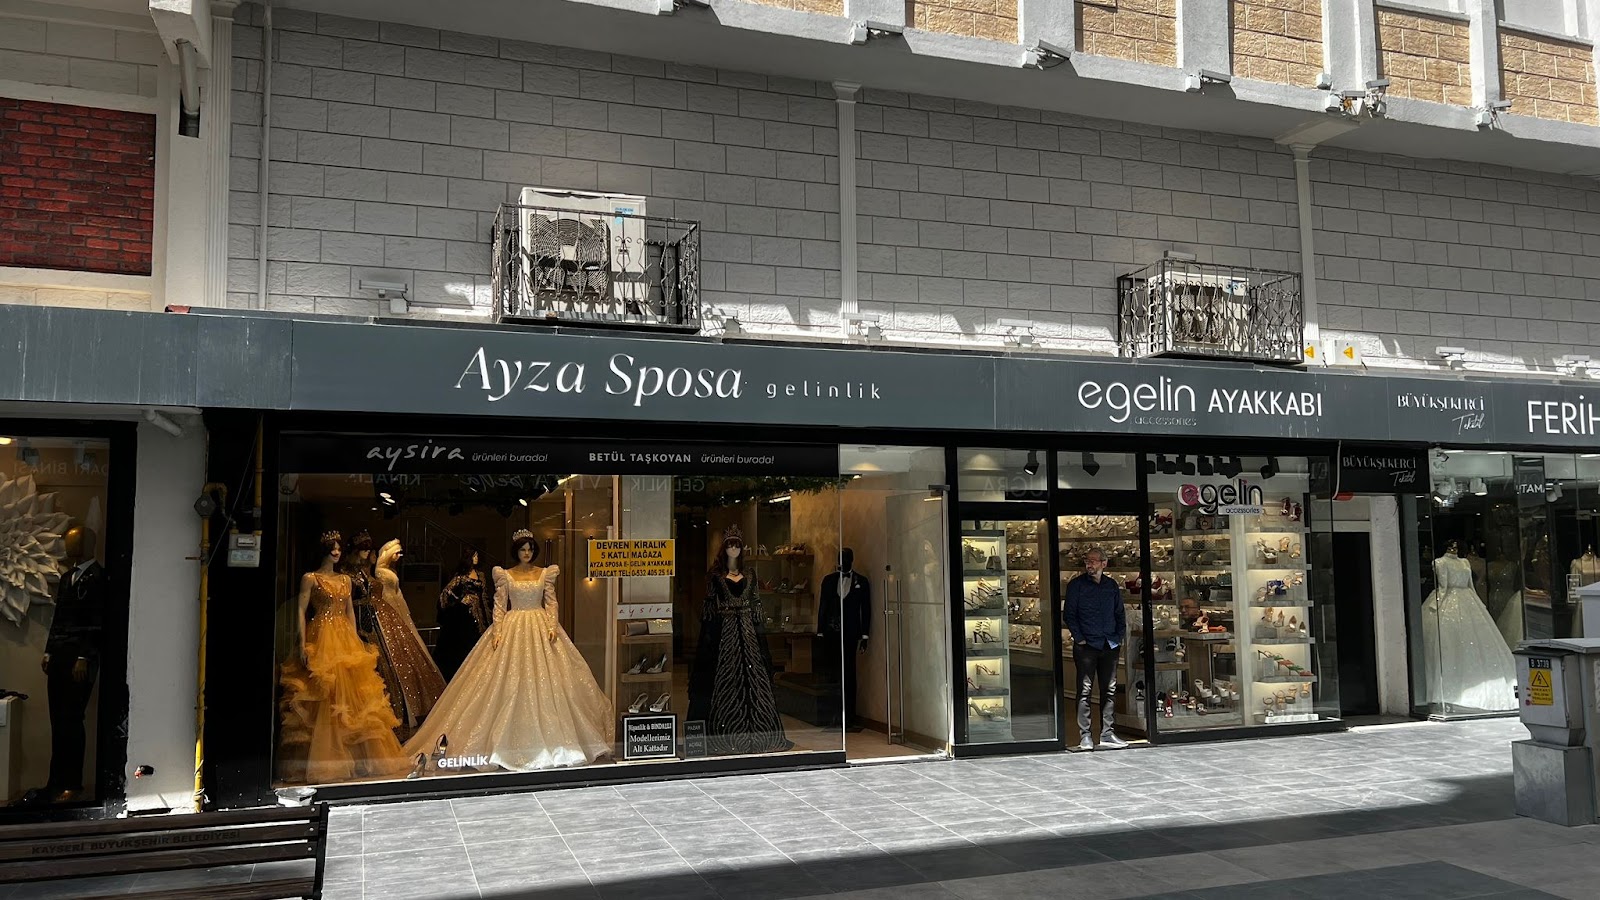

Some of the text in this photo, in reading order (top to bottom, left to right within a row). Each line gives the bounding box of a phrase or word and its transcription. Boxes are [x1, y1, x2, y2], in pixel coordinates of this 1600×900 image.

[454, 346, 744, 407] Ayza Sposa
[766, 380, 882, 400] gelinlik
[1078, 376, 1322, 423] egelin AYAKKABI
[1134, 416, 1197, 426] accessories
[366, 439, 548, 471] aysira ürünleri burada!
[589, 451, 775, 465] BETÜL TAŞKOYAN ürünleri burada!
[1177, 479, 1263, 515] egelin
[596, 540, 667, 550] DEVREN KİRALIK
[601, 550, 662, 559] 5 KATLI MAĞAZA
[619, 606, 671, 617] aysira
[630, 733, 671, 742] Modellerimiz
[633, 744, 643, 753] Alt
[438, 754, 488, 768] GELİNLİK
